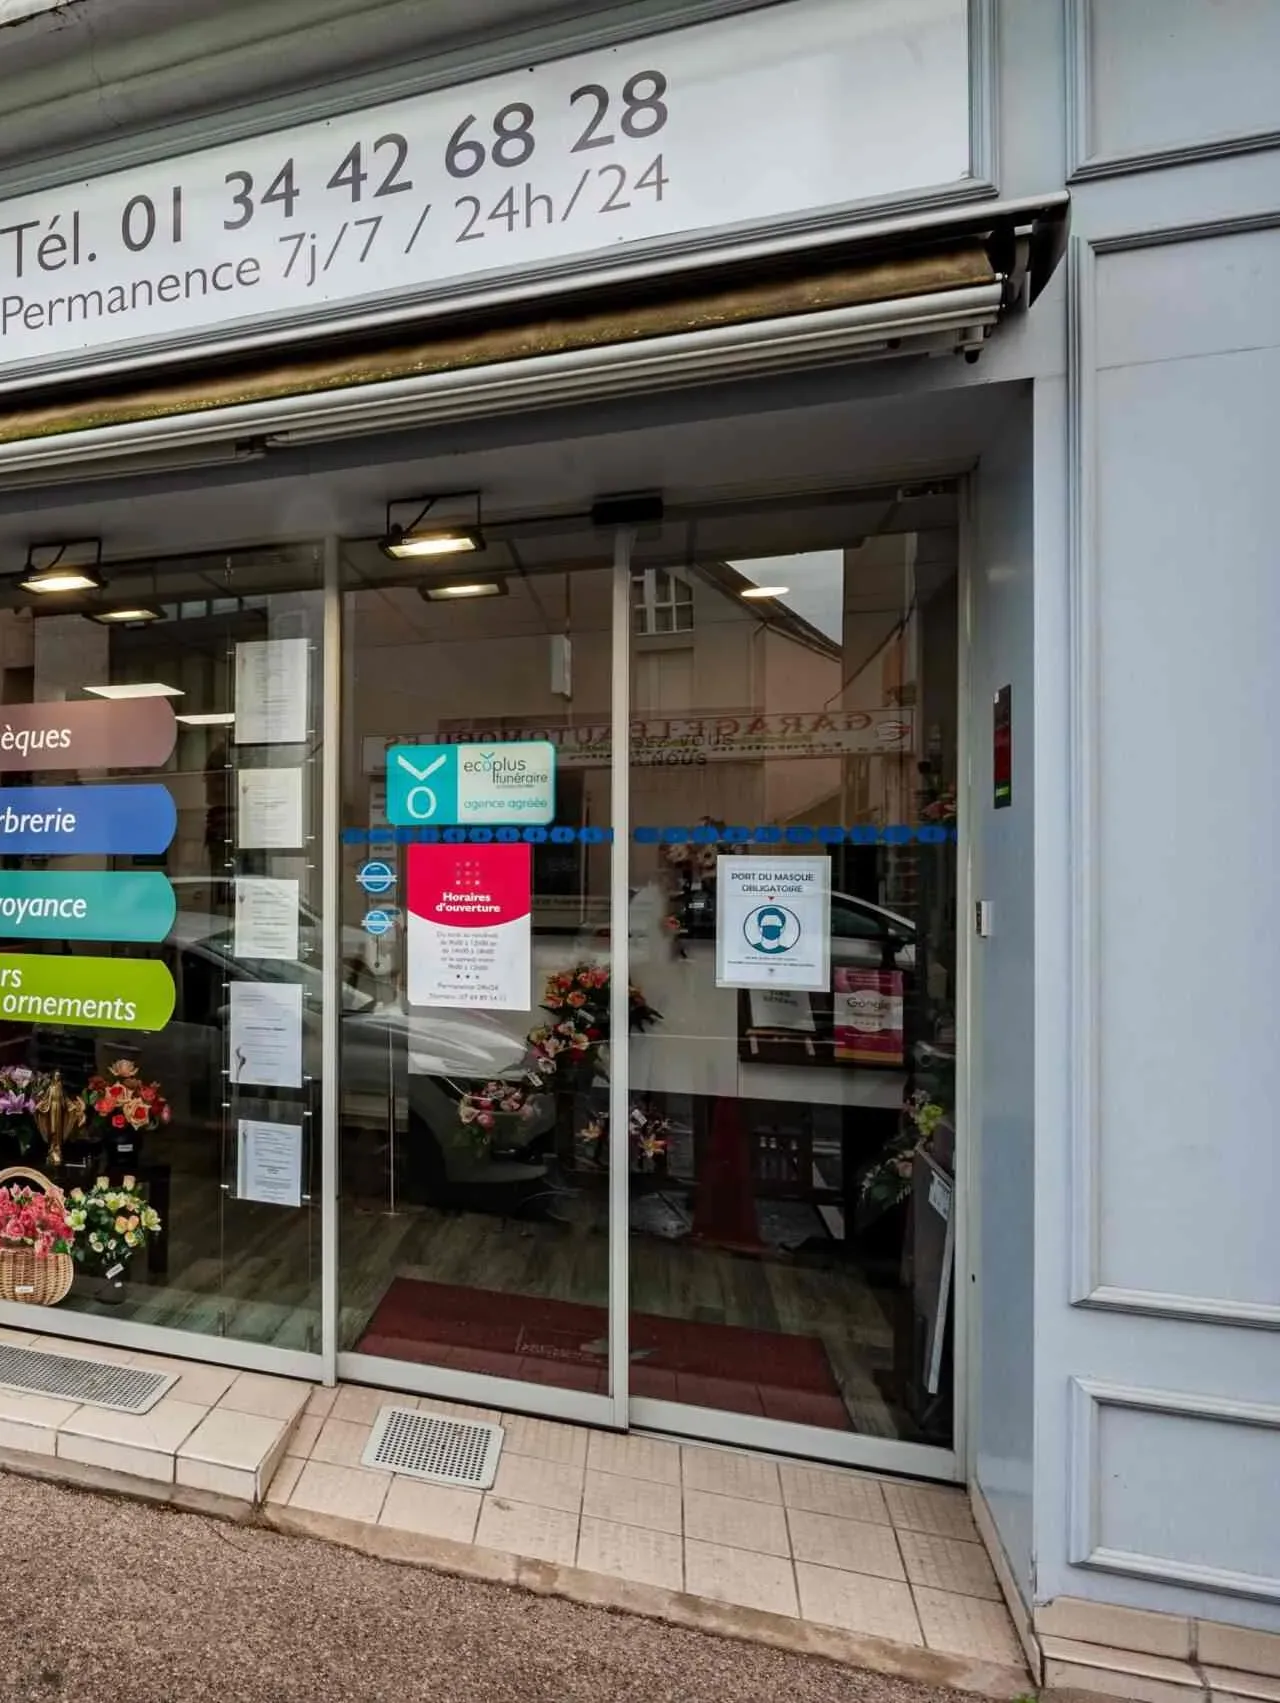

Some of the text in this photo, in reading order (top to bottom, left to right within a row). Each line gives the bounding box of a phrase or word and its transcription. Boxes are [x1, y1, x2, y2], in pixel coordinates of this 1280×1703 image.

[0, 70, 669, 278] Tél. 01 34 42 68 28
[0, 253, 261, 335] Permanence
[278, 215, 383, 289] 7j/7
[454, 153, 670, 245] 24h/24
[774, 873, 815, 881] MASQUE
[435, 902, 501, 912] d'ouverture
[442, 892, 491, 902] Horaires
[3, 992, 136, 1022] ornements
